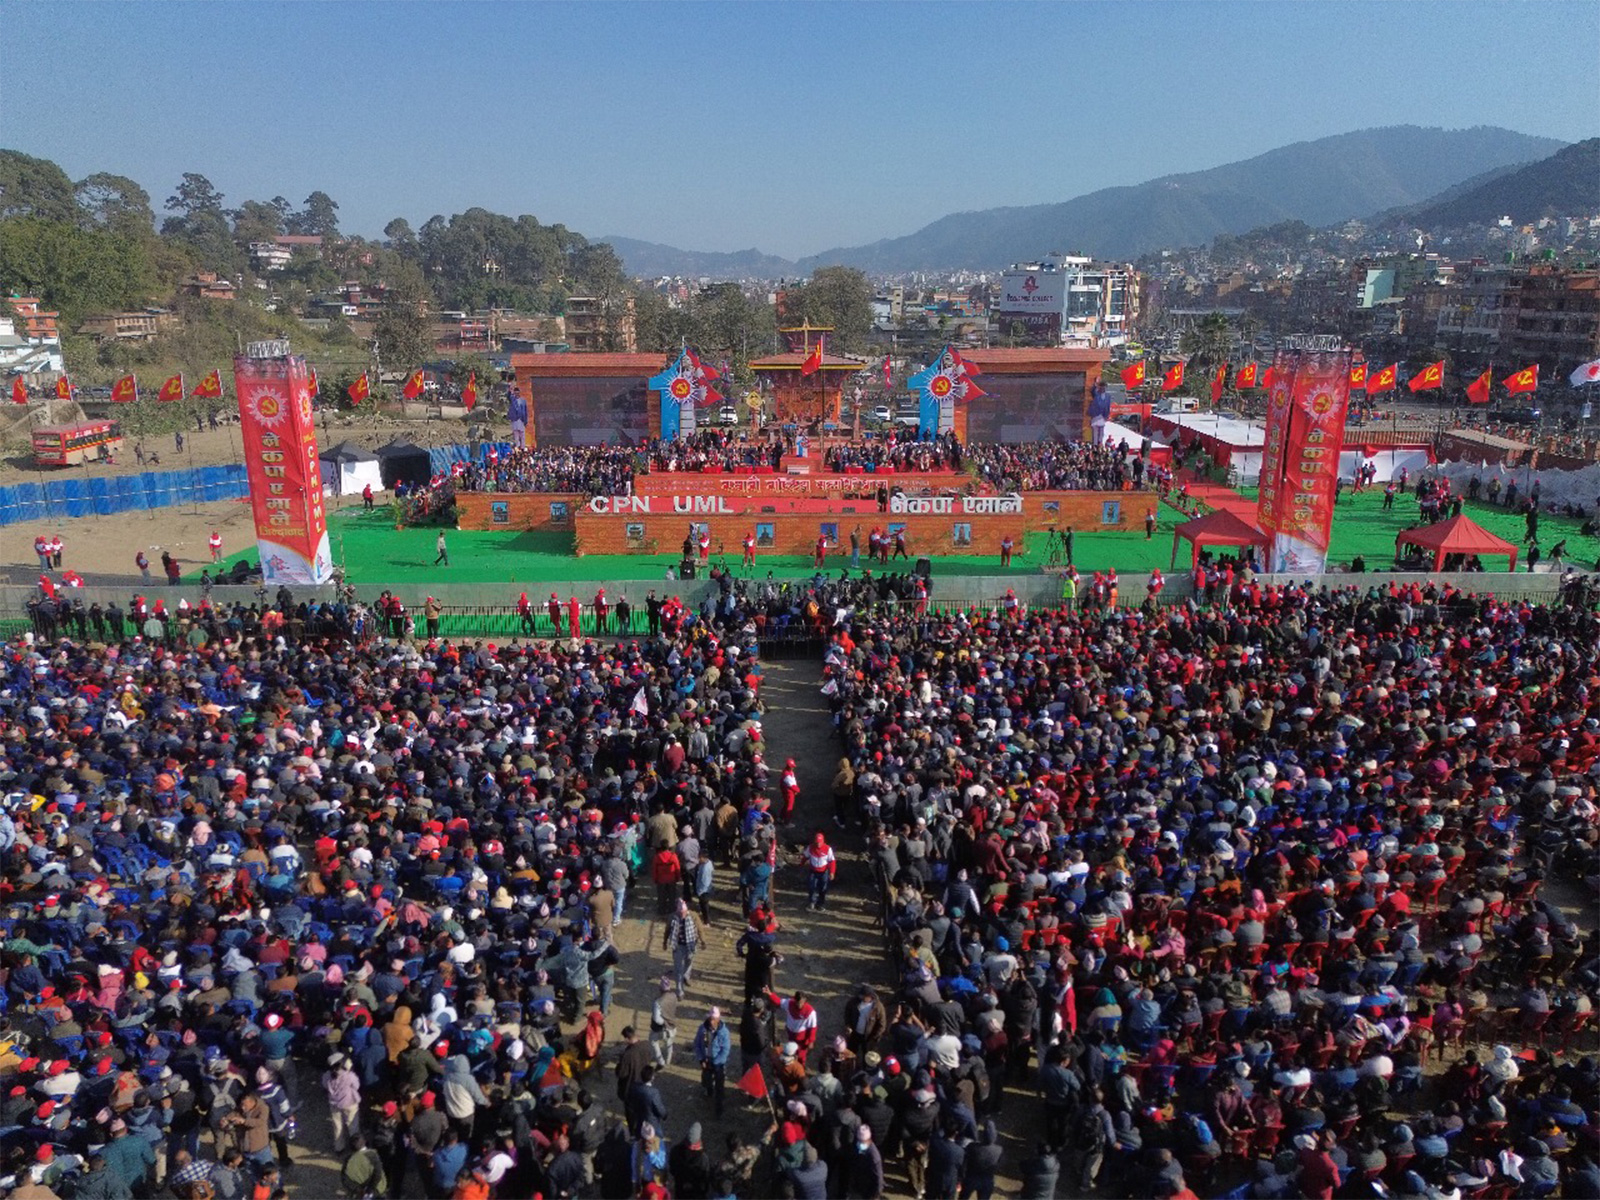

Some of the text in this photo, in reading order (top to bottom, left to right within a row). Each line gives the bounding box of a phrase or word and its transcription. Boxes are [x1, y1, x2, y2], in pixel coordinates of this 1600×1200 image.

[590, 495, 734, 513] CPN UML
[890, 492, 1024, 514] नेकपा एमाले
